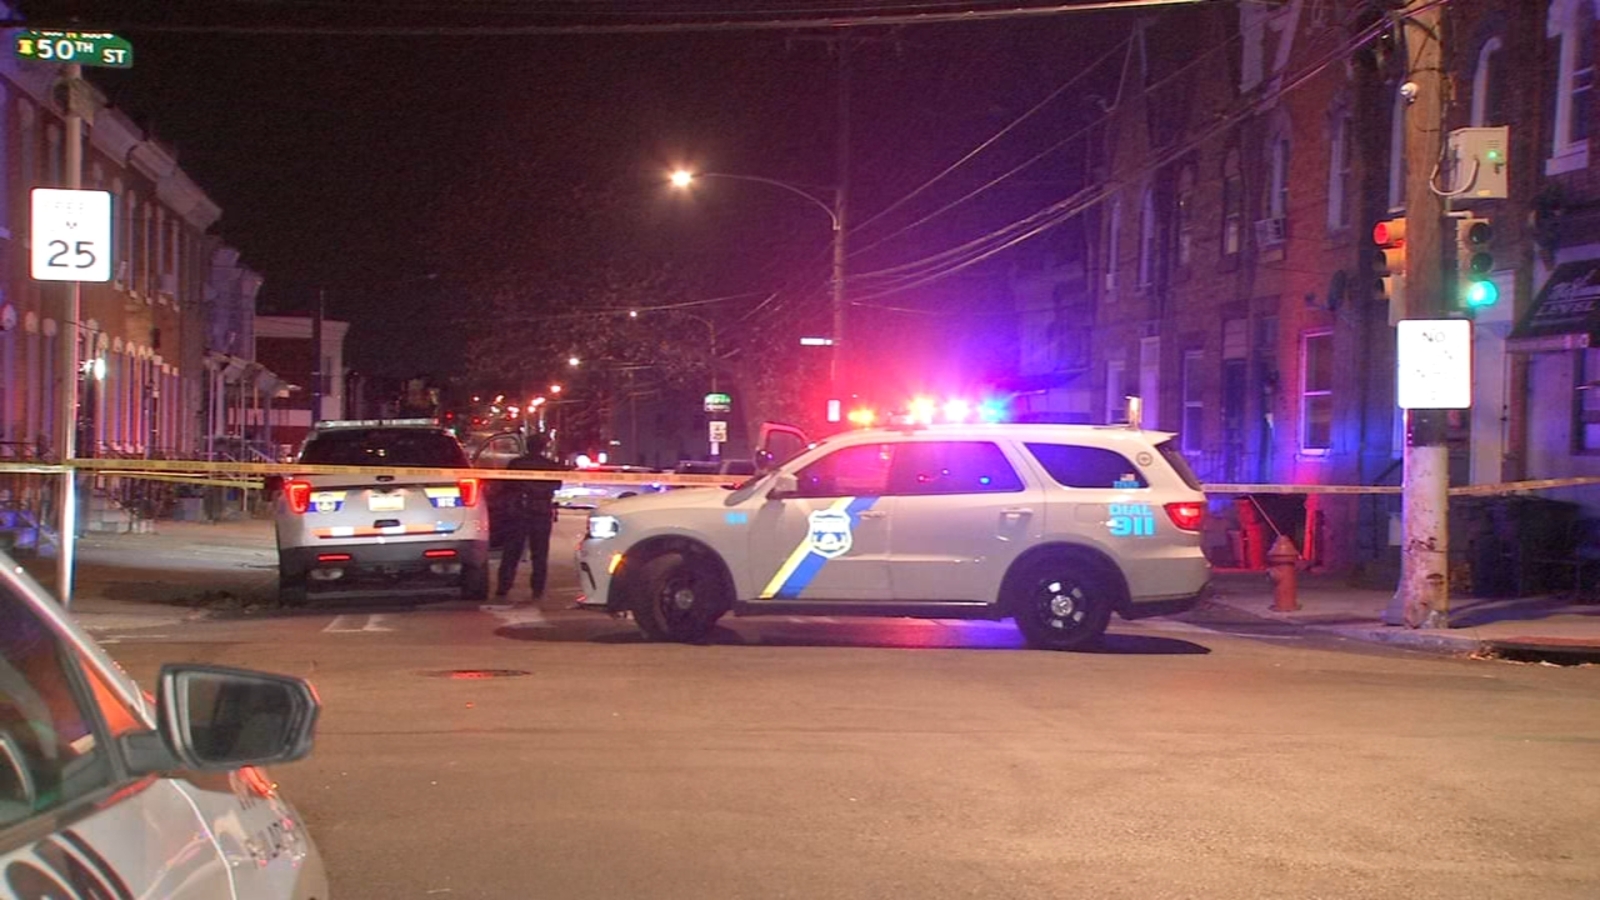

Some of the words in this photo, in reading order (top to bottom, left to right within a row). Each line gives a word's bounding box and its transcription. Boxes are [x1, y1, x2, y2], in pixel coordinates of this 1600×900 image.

[37, 39, 94, 60] 50TH
[102, 49, 127, 63] ST
[47, 239, 97, 269] 25
[1109, 503, 1153, 515] DIAL
[1108, 516, 1155, 536] 911
